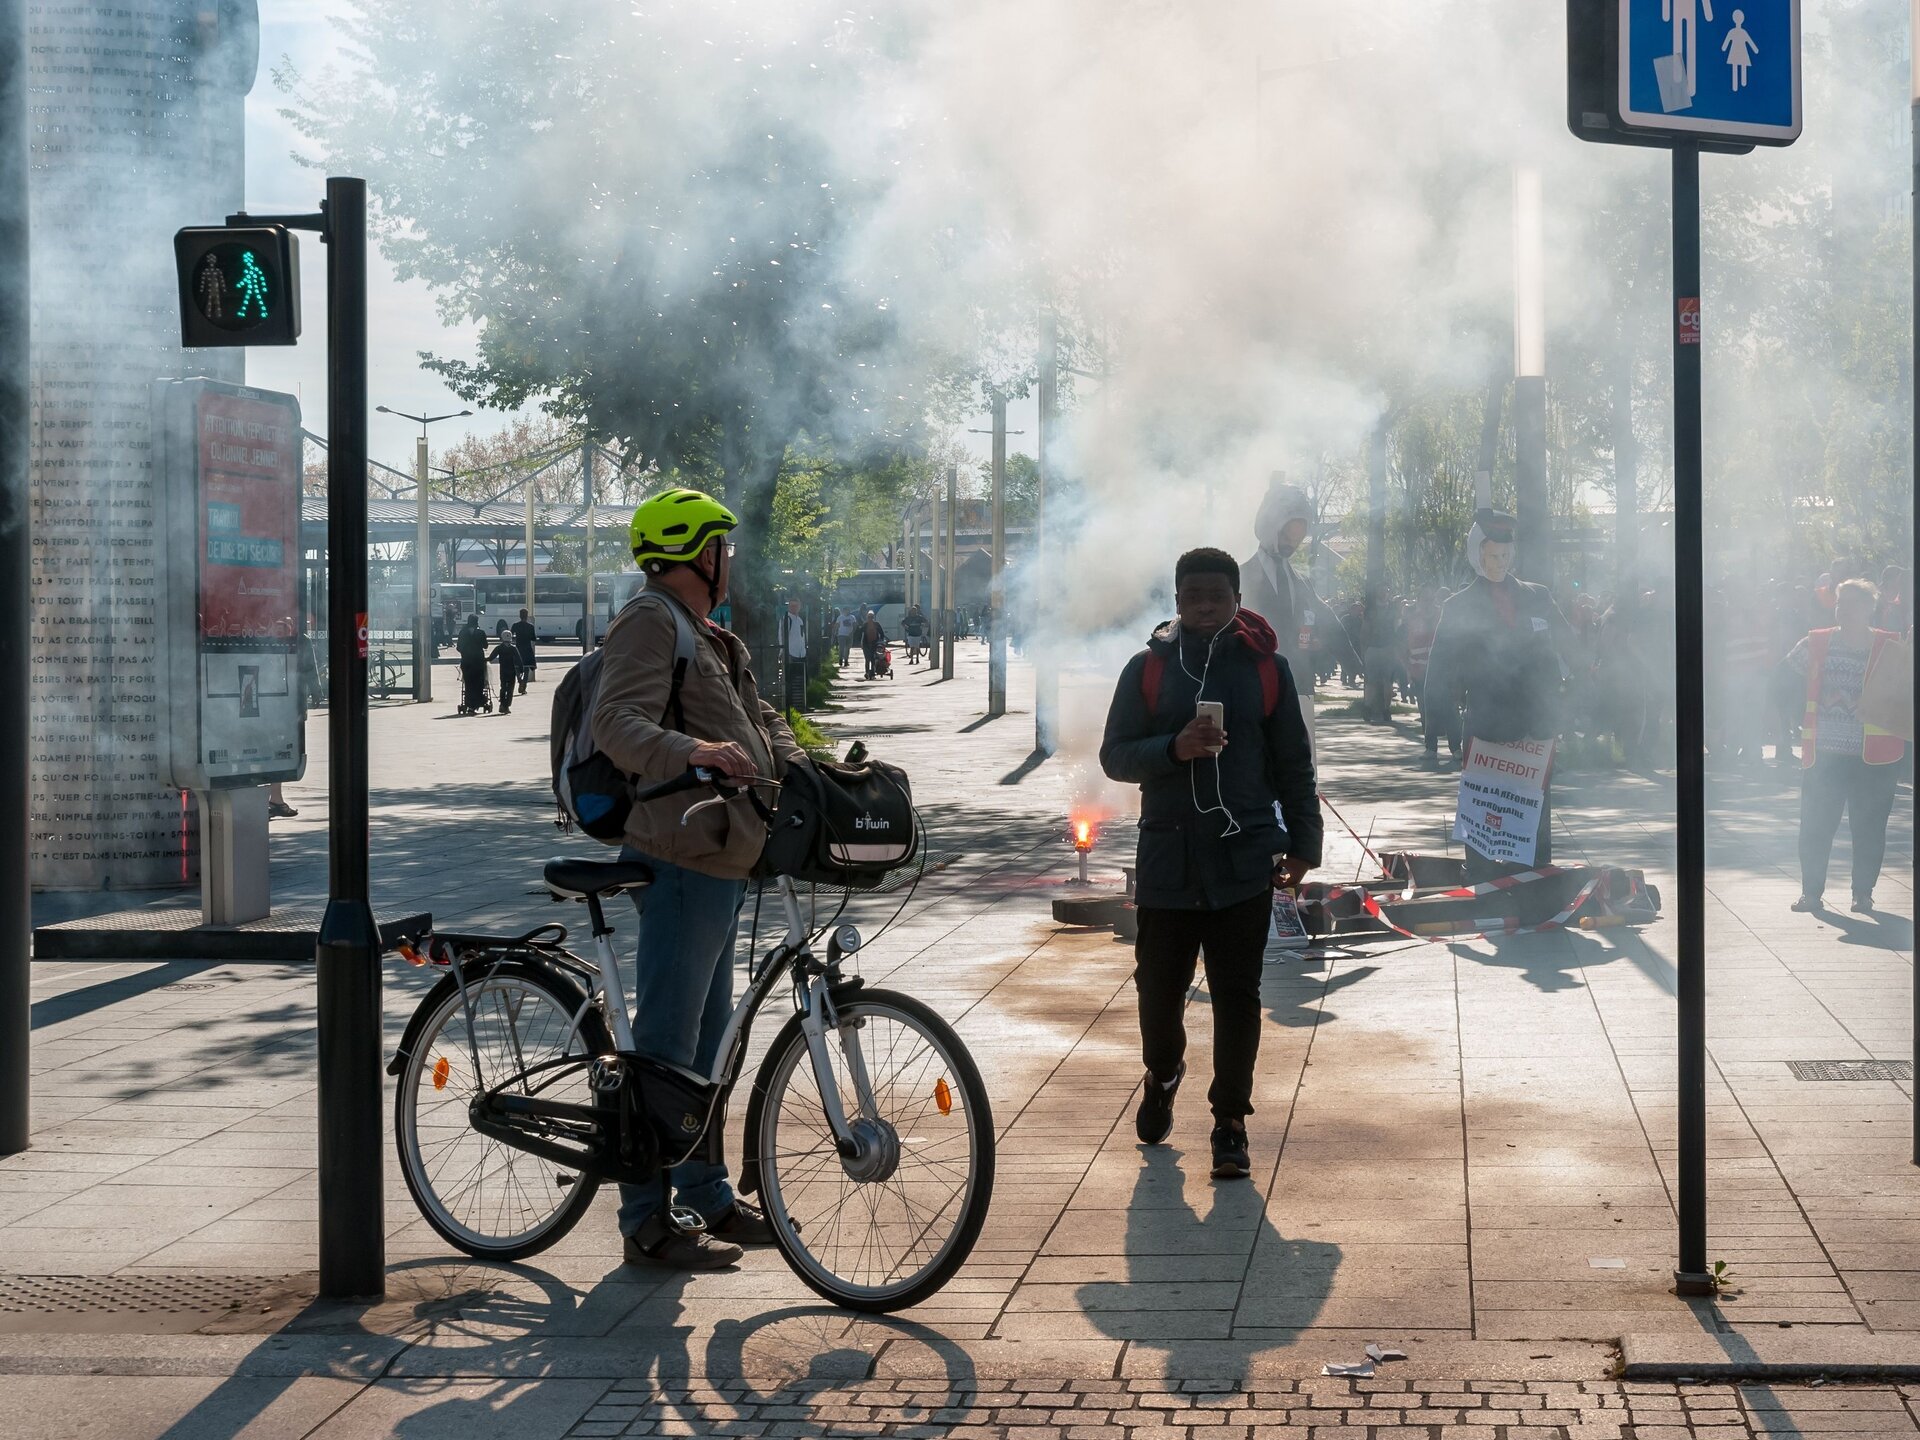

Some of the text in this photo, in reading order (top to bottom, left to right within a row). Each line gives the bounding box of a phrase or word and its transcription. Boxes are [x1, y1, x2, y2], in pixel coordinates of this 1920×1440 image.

[44, 381, 89, 390] SURTOUT
[57, 440, 84, 448] VAUT
[43, 479, 70, 488] VENT
[45, 498, 81, 508] QU'ON
[87, 499, 100, 508] SE
[44, 518, 103, 528] L'HISTOIRE
[32, 537, 47, 546] ON
[52, 537, 79, 546] TEND
[208, 540, 219, 559] DE
[238, 543, 248, 561] EN
[32, 557, 61, 566] C'EST
[66, 557, 89, 566] FAIT
[57, 577, 84, 586] TOUT
[40, 597, 53, 605] DU
[57, 597, 84, 605] TOUT
[116, 597, 148, 606] PASSE
[40, 616, 49, 625] SI
[53, 616, 65, 625] LA
[69, 616, 120, 625] BRANCHE
[32, 636, 44, 645] TU
[48, 636, 61, 645] AS
[66, 634, 117, 645] CRACHÉE
[134, 636, 147, 645] LA
[73, 655, 88, 664] NE
[92, 655, 115, 665] FAIT
[118, 655, 138, 665] PAS
[64, 675, 83, 684] N'A
[87, 675, 106, 684] PAS
[110, 675, 125, 684] DE
[52, 714, 106, 723] HEUREUX
[75, 754, 118, 762] PIMENT
[1473, 752, 1539, 780] INTERDIT
[42, 773, 79, 782] QU'ON
[84, 773, 125, 783] FOULE,
[130, 773, 145, 781] UN
[1464, 780, 1481, 793] NON
[84, 793, 99, 801] CE
[1472, 797, 1524, 820] FERROVIAIRE
[56, 812, 93, 822] SIMPLE
[96, 811, 129, 821] SUJET
[132, 810, 164, 821] PRIVÉ,
[168, 811, 180, 819] UN
[1461, 813, 1475, 826] OUI
[1482, 824, 1492, 835] LA
[68, 832, 148, 841] SOUVIENS-TOI
[1476, 830, 1516, 849] ENSEMBLE
[1467, 833, 1513, 857] POUR LE FER
[52, 852, 79, 861] C'EST
[83, 852, 110, 862] DANS
[113, 851, 161, 861] L'INSTANT
